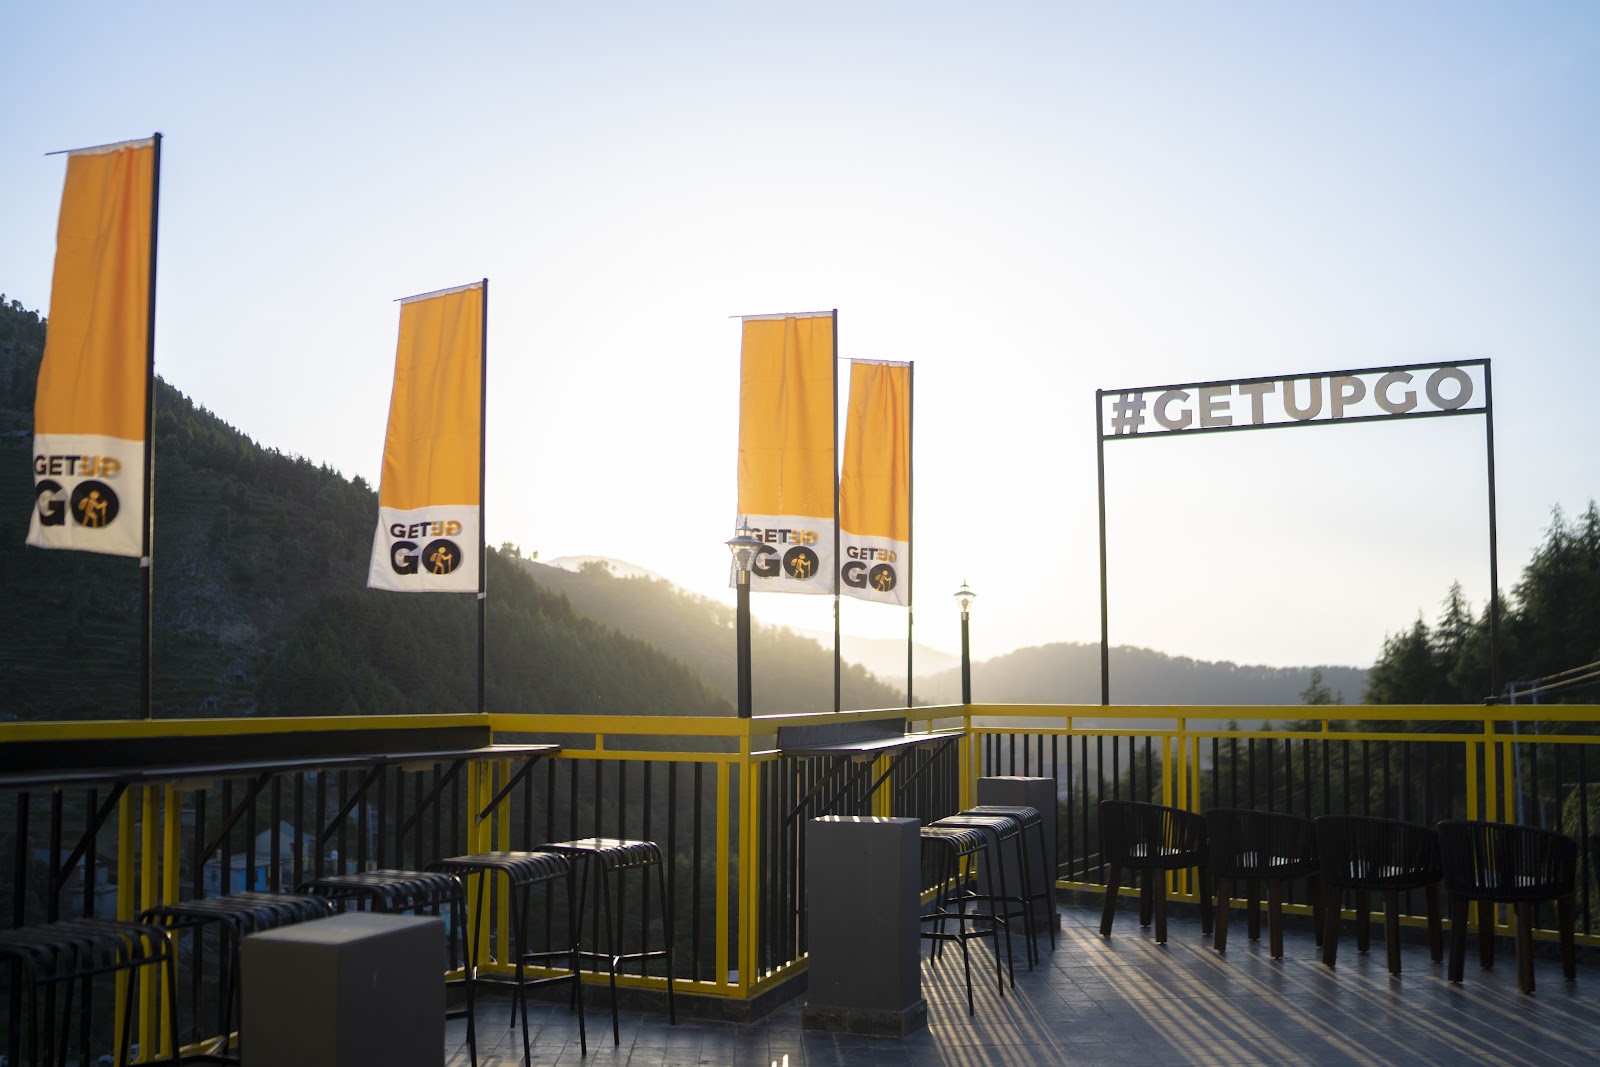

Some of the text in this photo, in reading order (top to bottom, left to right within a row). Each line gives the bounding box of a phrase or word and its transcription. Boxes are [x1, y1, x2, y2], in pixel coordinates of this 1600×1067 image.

[1111, 366, 1473, 435] #GETUPGO
[34, 454, 122, 477] GETUP
[35, 479, 120, 528] GO
[390, 520, 462, 539] GETUP
[390, 538, 462, 576] GO
[751, 544, 819, 579] GO
[846, 546, 897, 563] GETUP
[841, 561, 897, 592] GO
